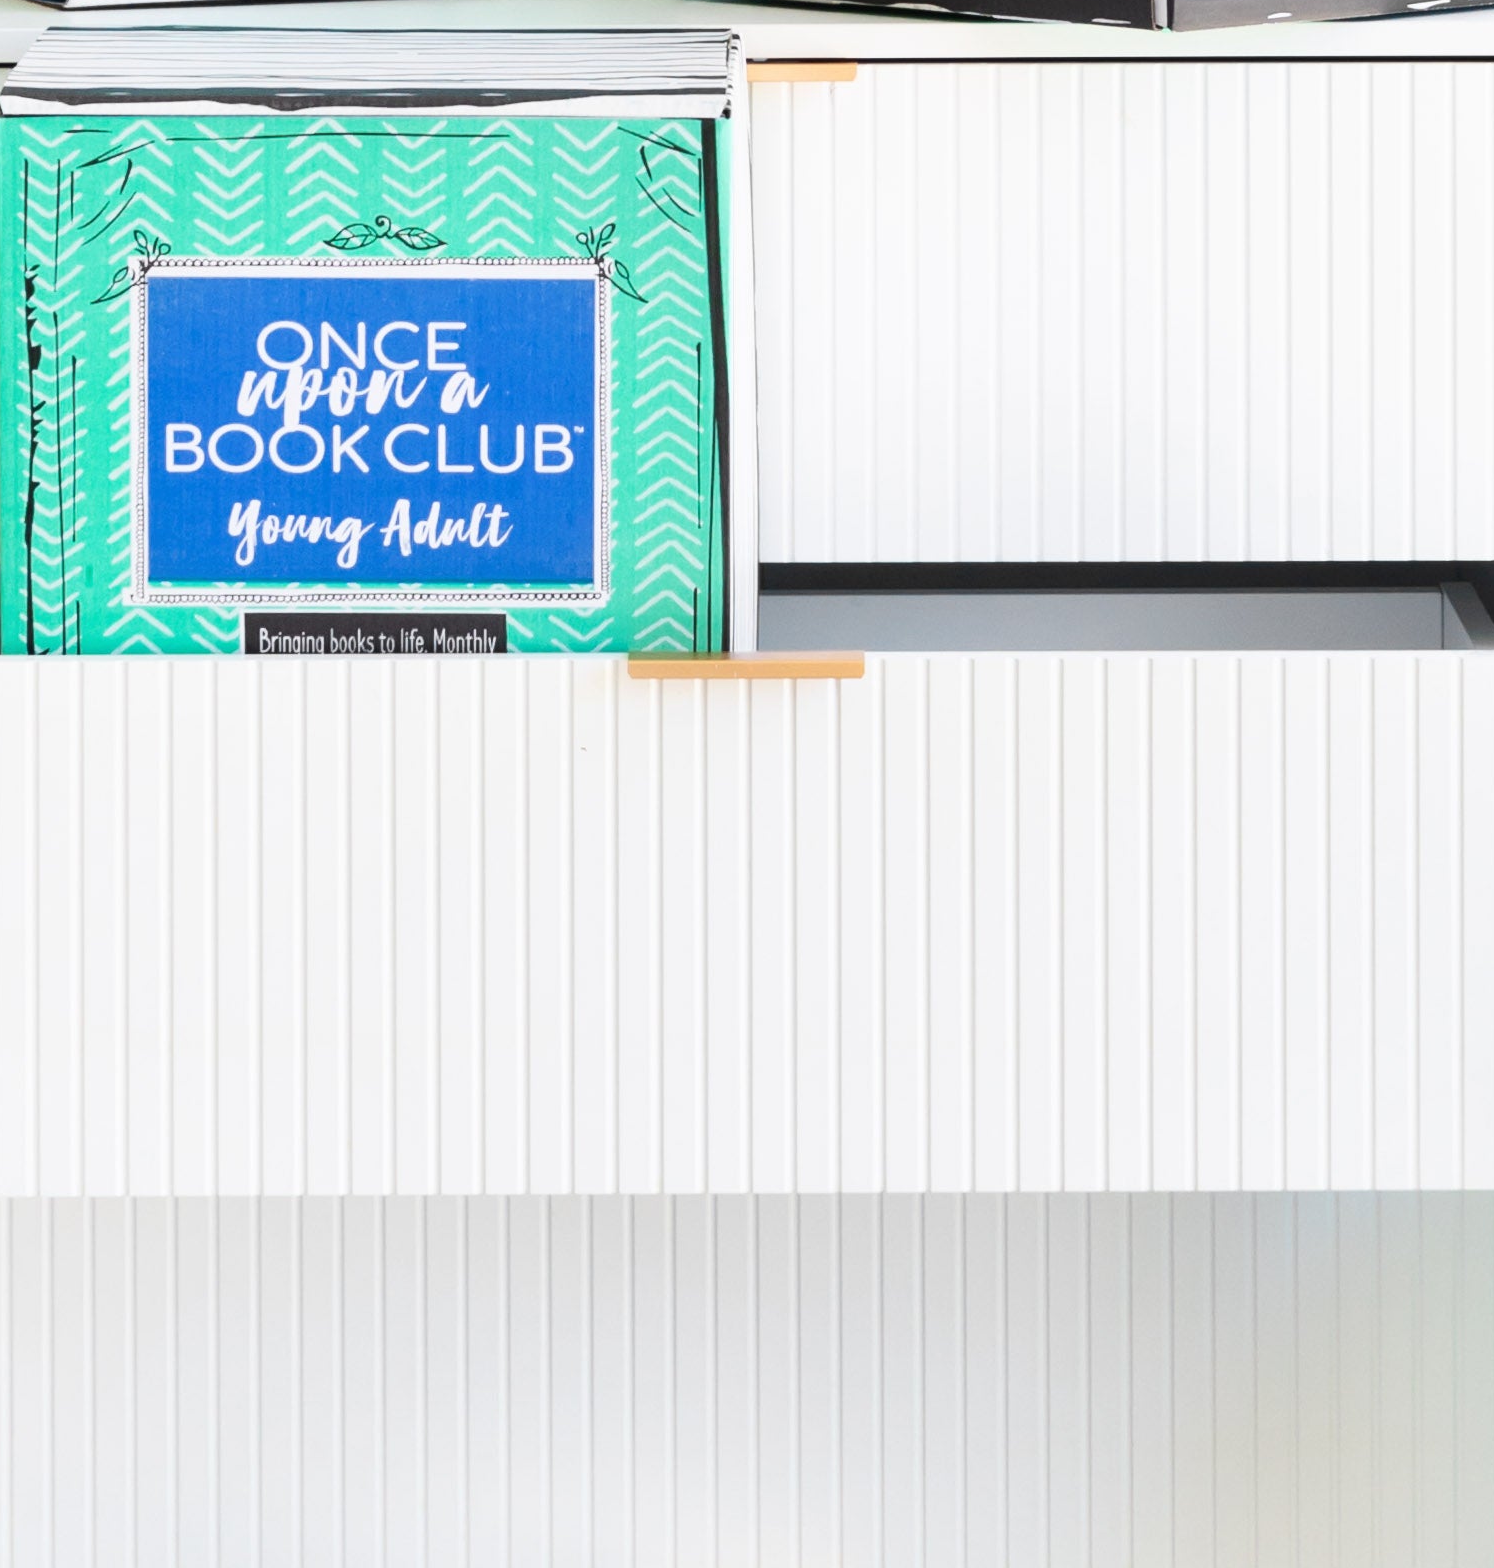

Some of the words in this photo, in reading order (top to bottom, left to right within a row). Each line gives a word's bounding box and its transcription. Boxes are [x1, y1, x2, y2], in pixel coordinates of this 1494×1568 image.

[256, 320, 467, 371] ONCE
[236, 366, 428, 431] upon
[440, 370, 490, 414] a
[165, 423, 370, 474] BOOK
[228, 498, 376, 569] Young
[379, 498, 514, 558] Adult
[259, 627, 325, 654] Bringing
[330, 627, 375, 654] books
[379, 632, 395, 654] to
[433, 627, 497, 654] Monthly
